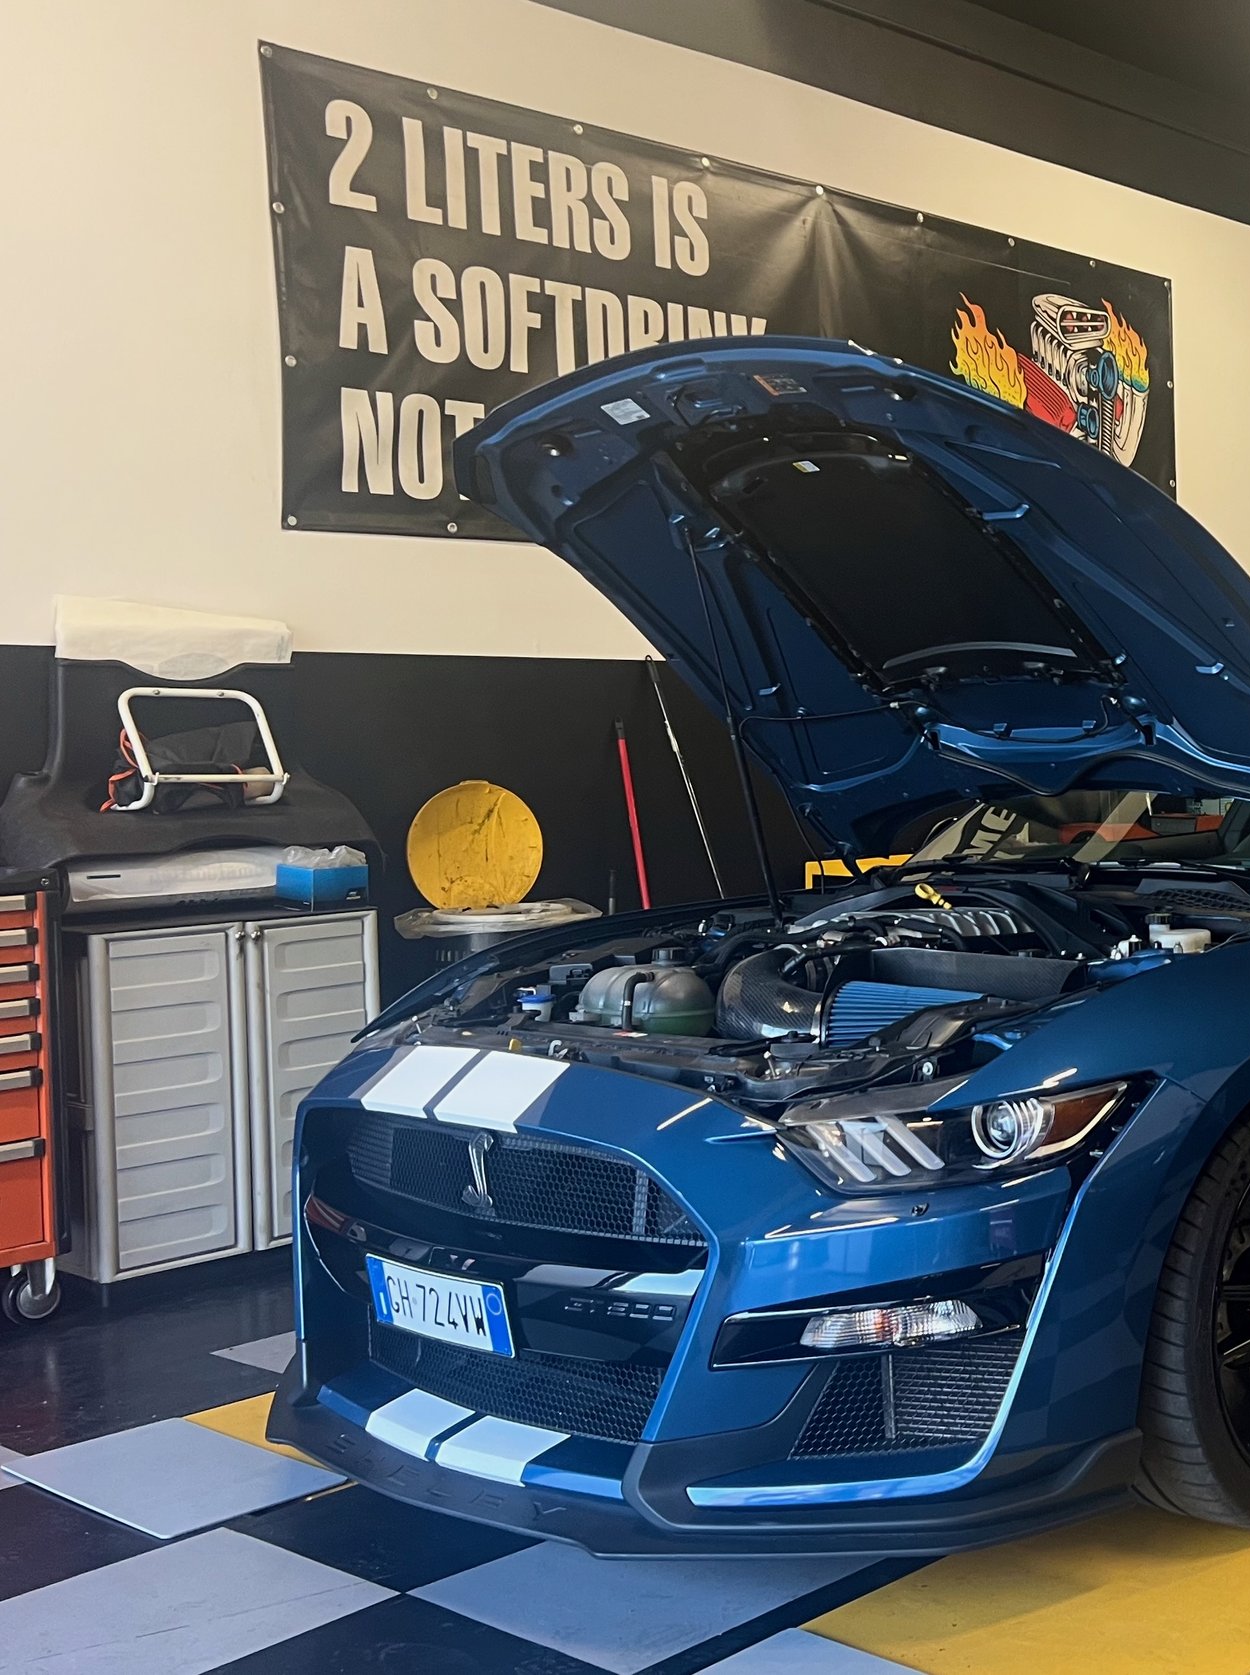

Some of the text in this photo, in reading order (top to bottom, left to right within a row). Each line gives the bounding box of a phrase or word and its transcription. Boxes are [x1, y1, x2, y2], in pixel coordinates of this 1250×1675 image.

[325, 99, 710, 277] 2 LITERS IS
[338, 245, 389, 355] A
